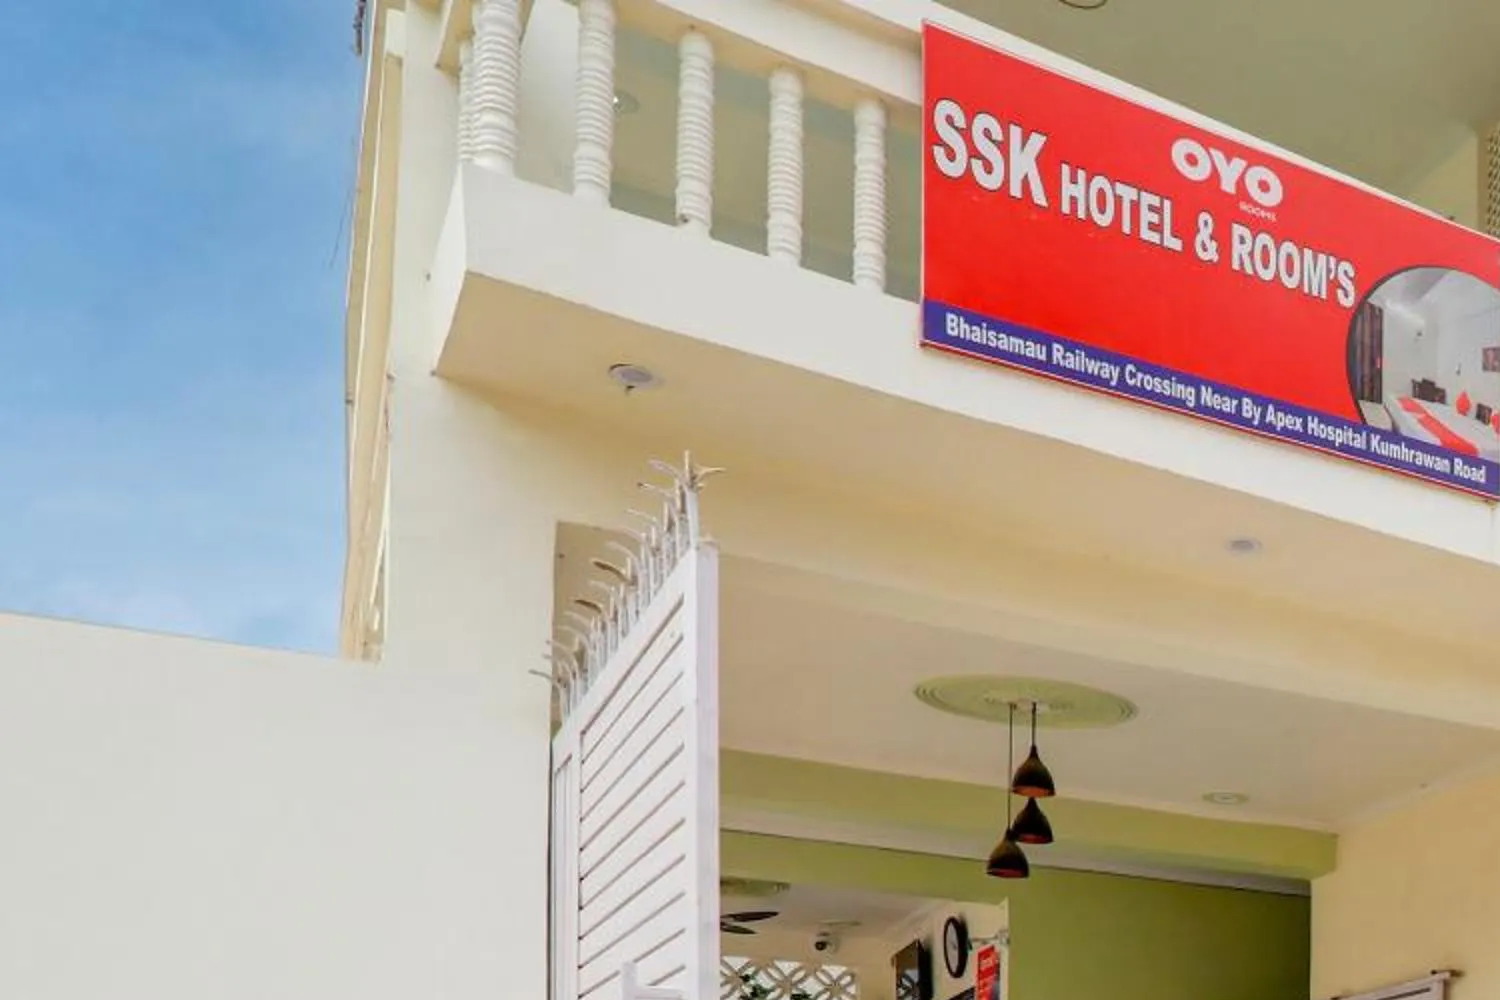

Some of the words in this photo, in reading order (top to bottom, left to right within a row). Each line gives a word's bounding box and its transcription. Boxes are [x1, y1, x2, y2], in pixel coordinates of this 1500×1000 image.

[932, 98, 1049, 208] SSK
[1060, 161, 1184, 252] HOTEL
[1194, 211, 1219, 262] &
[1171, 137, 1284, 208] OYO
[945, 312, 1047, 361] Bhaisamau
[1052, 343, 1120, 385] Railway
[1125, 365, 1195, 406] Crossing
[1200, 385, 1238, 413] Near
[1241, 398, 1262, 424] By
[1265, 404, 1303, 434] Apex
[1307, 415, 1367, 450] Hospital
[1370, 434, 1450, 473] Kumhrawan
[1453, 458, 1486, 483] Road
